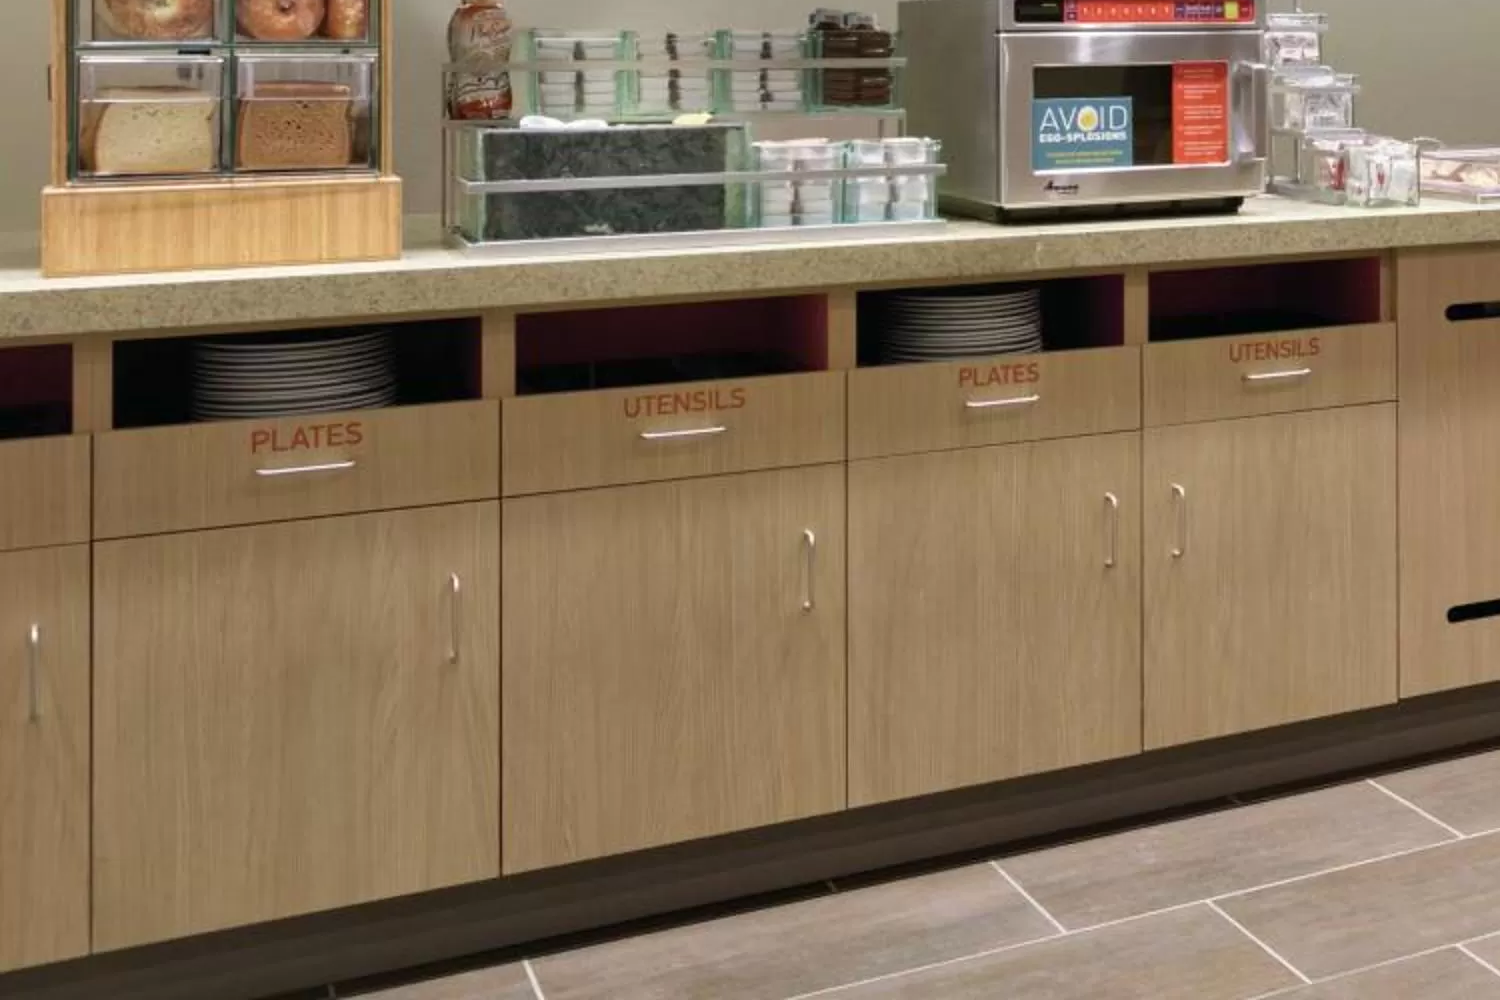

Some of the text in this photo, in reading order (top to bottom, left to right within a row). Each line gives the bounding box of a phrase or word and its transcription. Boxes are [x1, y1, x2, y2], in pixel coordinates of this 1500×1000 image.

[1039, 105, 1128, 132] AVOID
[1228, 337, 1321, 363] UTENSILS
[958, 362, 1040, 388] PLATES
[623, 387, 746, 419] UTENSILS
[250, 421, 363, 455] PLATES
